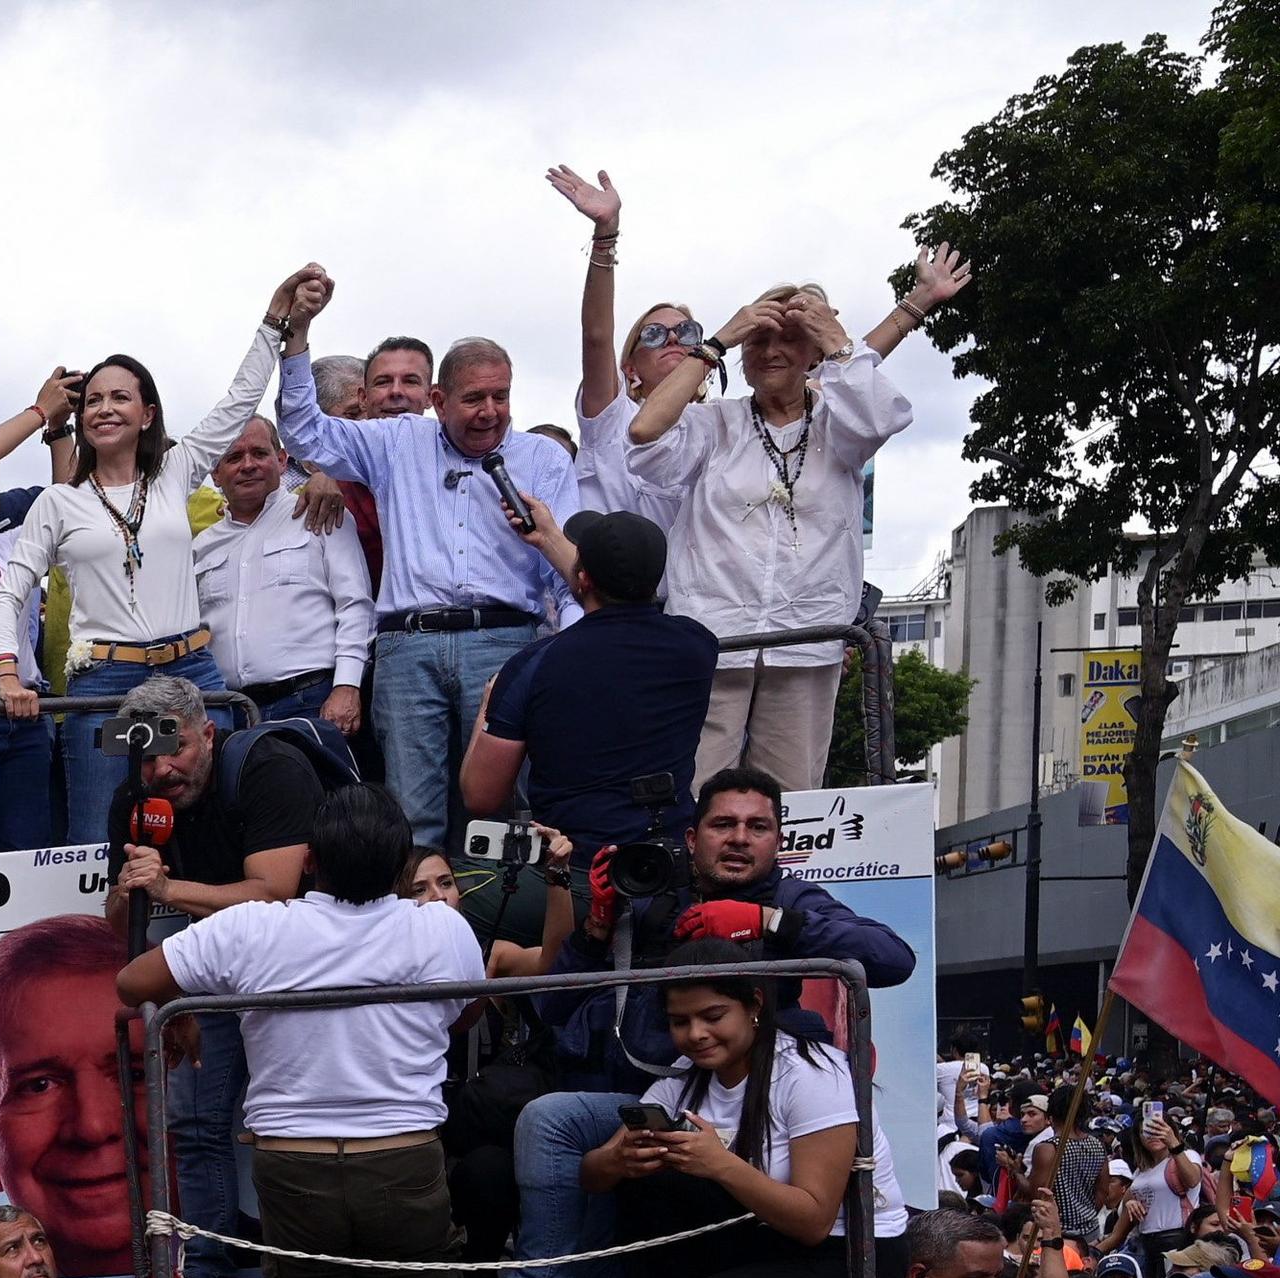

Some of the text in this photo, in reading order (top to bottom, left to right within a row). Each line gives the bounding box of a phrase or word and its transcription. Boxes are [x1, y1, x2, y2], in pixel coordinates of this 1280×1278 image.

[1088, 660, 1139, 681] Daka
[1083, 763, 1125, 776] DAK
[33, 850, 87, 867] Mesa
[782, 861, 900, 880] Democrática
